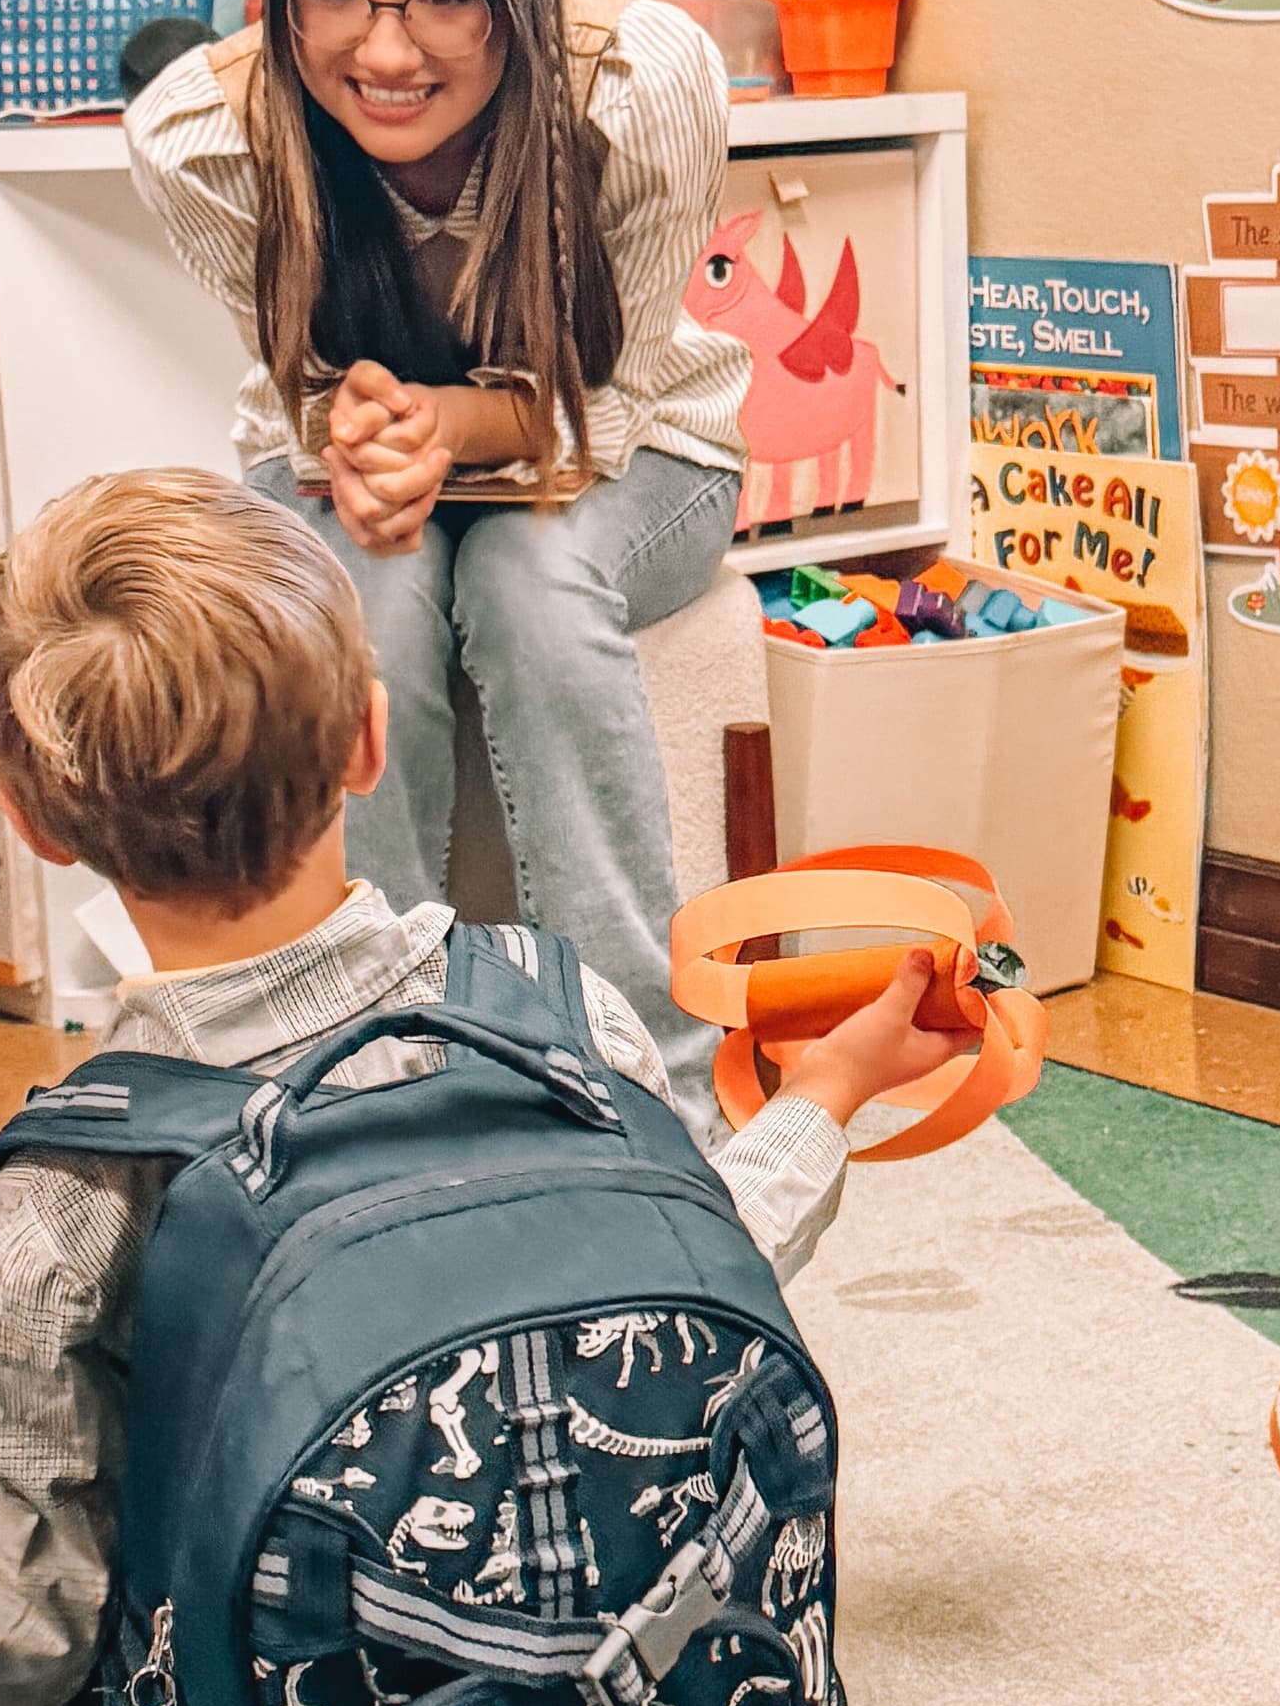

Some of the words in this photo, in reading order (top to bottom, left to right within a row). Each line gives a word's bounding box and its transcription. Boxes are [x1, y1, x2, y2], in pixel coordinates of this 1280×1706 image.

[1231, 216, 1270, 245] The
[1044, 279, 1151, 325] TOUCH,
[1032, 320, 1123, 357] SMELL
[1218, 382, 1257, 413] The
[999, 461, 1095, 509] Cake
[1103, 476, 1161, 538] All
[994, 528, 1061, 569] For
[1074, 521, 1155, 588] Me!
